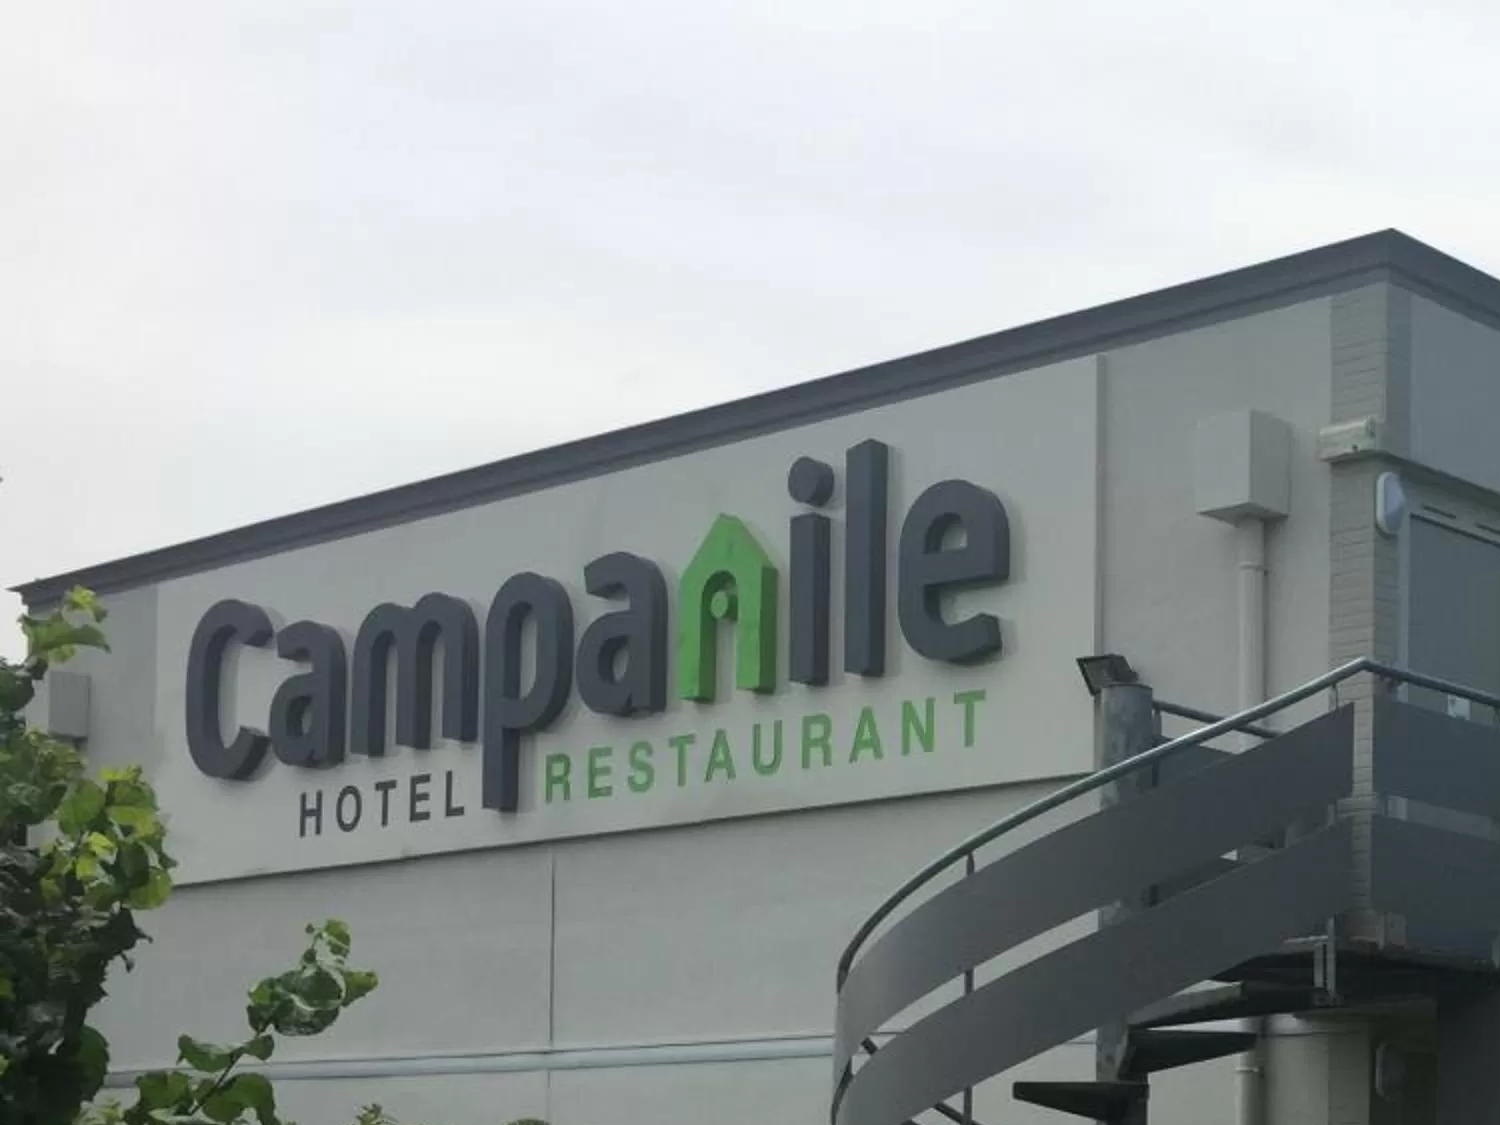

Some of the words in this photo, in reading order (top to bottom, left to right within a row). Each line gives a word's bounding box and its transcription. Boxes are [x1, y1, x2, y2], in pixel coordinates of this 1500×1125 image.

[185, 438, 1011, 813] Campanile
[299, 770, 465, 837] HOTEL
[544, 689, 987, 803] RESTAURANT
